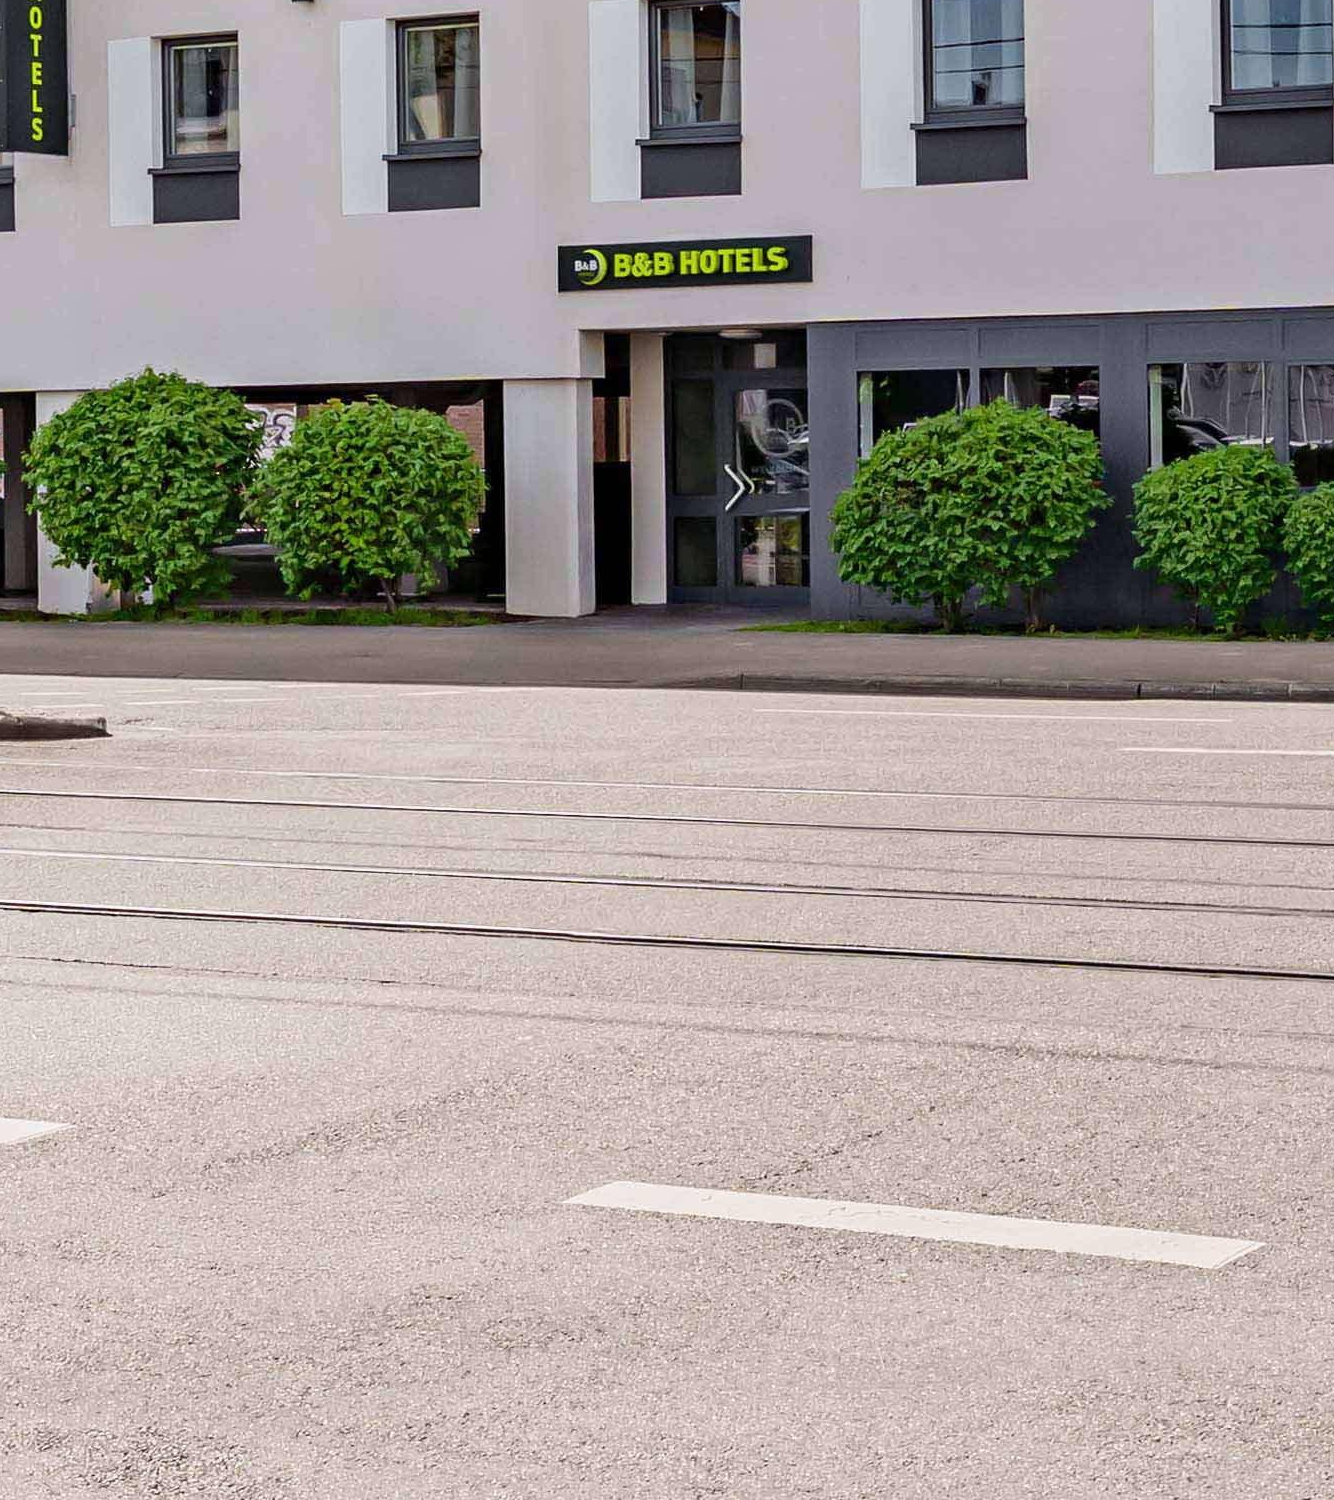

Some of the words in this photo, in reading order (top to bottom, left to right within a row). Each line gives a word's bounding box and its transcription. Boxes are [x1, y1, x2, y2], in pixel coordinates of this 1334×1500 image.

[574, 260, 598, 272] B&B
[613, 252, 675, 278] B&B
[680, 246, 790, 276] HOTELS
